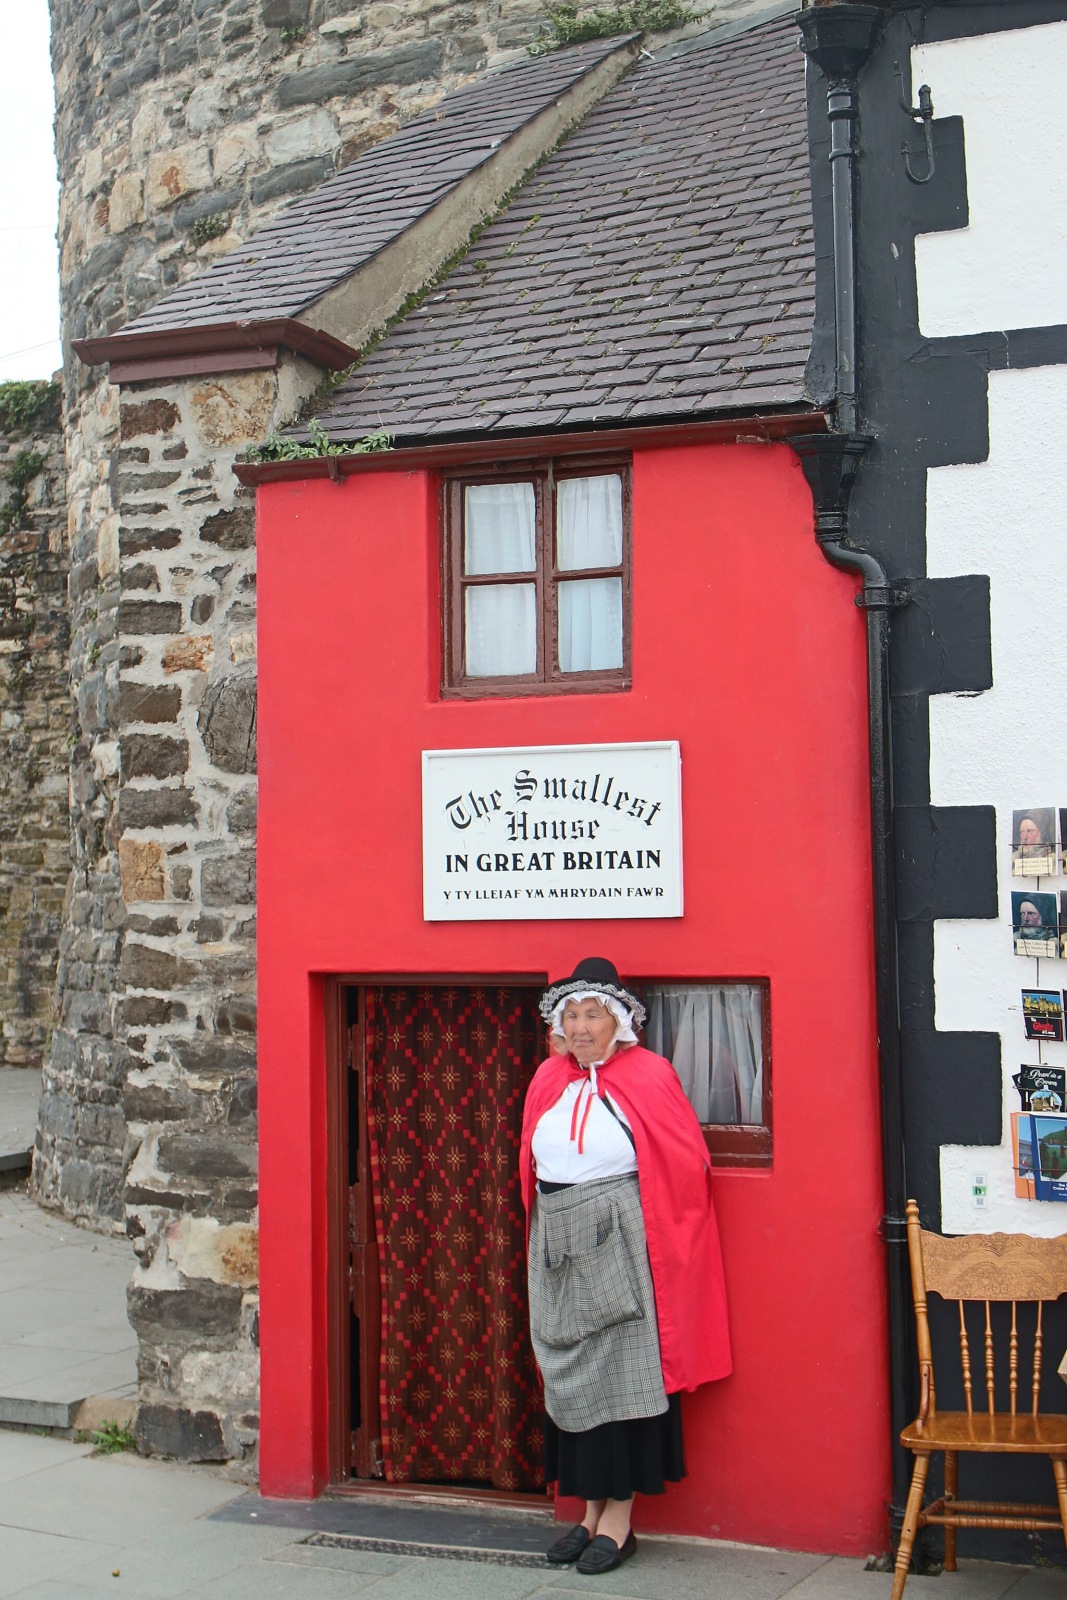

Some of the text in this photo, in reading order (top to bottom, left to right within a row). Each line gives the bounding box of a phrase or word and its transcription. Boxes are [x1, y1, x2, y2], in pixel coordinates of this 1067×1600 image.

[445, 769, 662, 830] The Smallest
[504, 810, 601, 842] House
[445, 849, 662, 873] IN GREAT BRITAIN
[443, 887, 665, 900] Y TY LLEIAF YM MHRYDAIN FAWR
